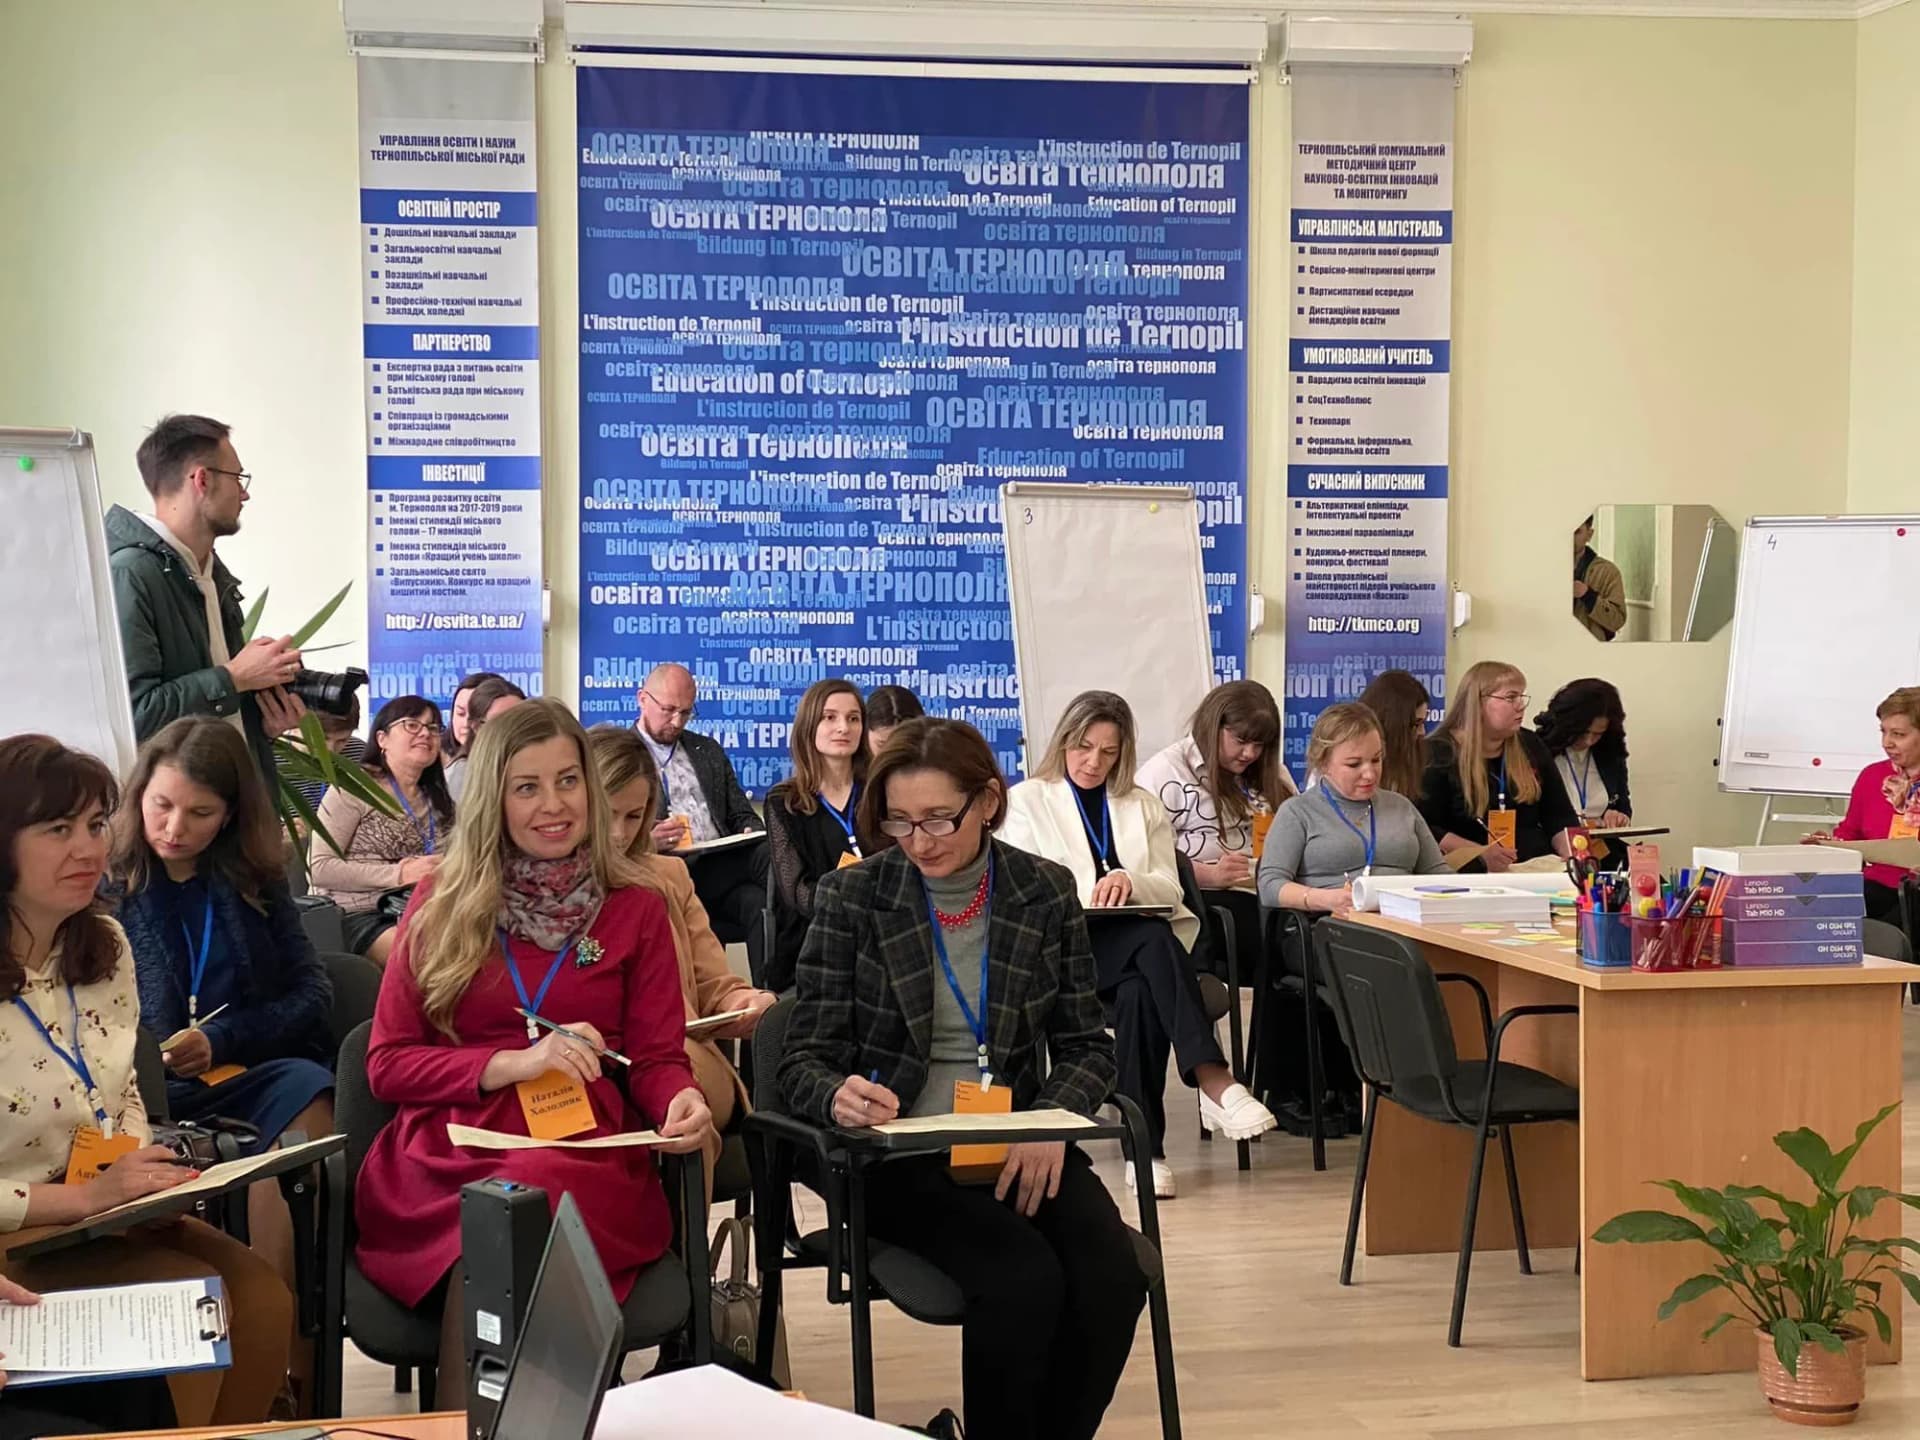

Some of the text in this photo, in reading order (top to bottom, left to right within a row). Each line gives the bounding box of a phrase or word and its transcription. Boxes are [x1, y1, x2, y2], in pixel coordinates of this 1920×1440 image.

[379, 135, 516, 149] УПРАВЛІННЯ ОСВІТИ І НАУКИ
[592, 132, 829, 164] ОСВІТА ТЕРНОПОЛЯ
[1299, 143, 1445, 157] ТЕРНОПІЛЬСЬКИЙ КОМУНАЛЬНИЙ
[371, 150, 525, 165] ТЕРНОПІЛЬСЬКОЇ МІСЬКОЇ РАДИ
[1147, 141, 1168, 160] de
[1171, 141, 1241, 162] Ternopil
[845, 154, 919, 172] Bildung in
[1327, 158, 1416, 172] МЕТОДИЧНИЙ ЦЕНТР
[1304, 173, 1438, 186] НАУКОВО-ОСВІТНІХ ІННОВАЦІЙ
[810, 177, 950, 201] тернополя
[1335, 188, 1407, 200] ТА МОНІТОРИНГУ
[398, 198, 501, 219] ОСВІТНІЙ ПРОСТІР
[1161, 196, 1176, 213] of
[1178, 197, 1237, 215] Ternopil
[748, 204, 888, 233] ТЕРНОПОЛЯ
[891, 211, 958, 230] Ternopil
[1298, 218, 1443, 237] УПРАВЛІНСЬКА МАГІСТРАЛЬ
[384, 227, 516, 240] Дошкільні навчальні заклади
[984, 220, 1166, 244] освіта тернополя
[385, 245, 501, 255] Загальноосвітні навчальні
[697, 235, 766, 257] Bildung
[770, 237, 787, 255] in
[842, 246, 1125, 280] ОСВІТА ТЕРНОПОЛЯ
[385, 270, 487, 281] Позашкільні навчальні
[385, 282, 423, 290] заклади
[608, 273, 844, 301] ОСВІТА ТЕРНОПОЛЯ
[386, 296, 522, 306] Професійно-технічні навчальні
[866, 294, 965, 315] de Ternopil
[428, 308, 464, 316] коледжі
[1086, 302, 1240, 322] освіта тернополя
[584, 314, 676, 331] L'instruction
[679, 316, 698, 331] de
[413, 334, 491, 352] ПАРТНЕРСТВО
[1127, 320, 1243, 353] Ternopil
[1304, 346, 1433, 365] УМОТИВОВАНИЙ УЧИТЕЛЬ
[387, 363, 432, 372] Експертна
[434, 365, 455, 373] рада
[1136, 361, 1217, 375] тернополя
[387, 374, 403, 382] при
[406, 374, 446, 382] міському
[780, 368, 806, 395] of
[388, 386, 440, 395] Батьківська
[466, 388, 481, 396] при
[484, 388, 524, 396] міському
[388, 397, 415, 405] голові
[697, 399, 911, 421] L'instruction de Ternopil
[388, 411, 432, 420] Співпраця
[445, 413, 509, 421] громадськими
[926, 397, 1208, 429] ОСВІТА ТЕРНОПОЛЯ
[388, 422, 451, 431] організаціями
[388, 437, 516, 446] Міжнародне співробітництво
[1081, 448, 1185, 471] of Ternopil
[422, 462, 486, 484] ІНВЕСТИЦІЇ
[1308, 471, 1425, 490] СУЧАСНИЙ ВИПУСКНИК
[593, 478, 829, 505] ОСВІТА ТЕРНОПОЛЯ
[400, 503, 446, 512] Тернополя
[460, 503, 500, 512] 2017-2019
[502, 505, 522, 513] роки
[1024, 507, 1033, 525] 3
[464, 516, 501, 525] міського
[469, 542, 506, 550] міського
[1767, 535, 1777, 550] 4
[390, 553, 420, 561] голови
[591, 582, 663, 605] освіта
[385, 613, 525, 631] http://osvita.te.ua/
[613, 613, 681, 634] освіта
[1308, 616, 1420, 633] http://tkmco.org
[423, 651, 479, 669] освіта
[750, 647, 918, 666] ОСВІТА ТЕРНОПОЛЯ
